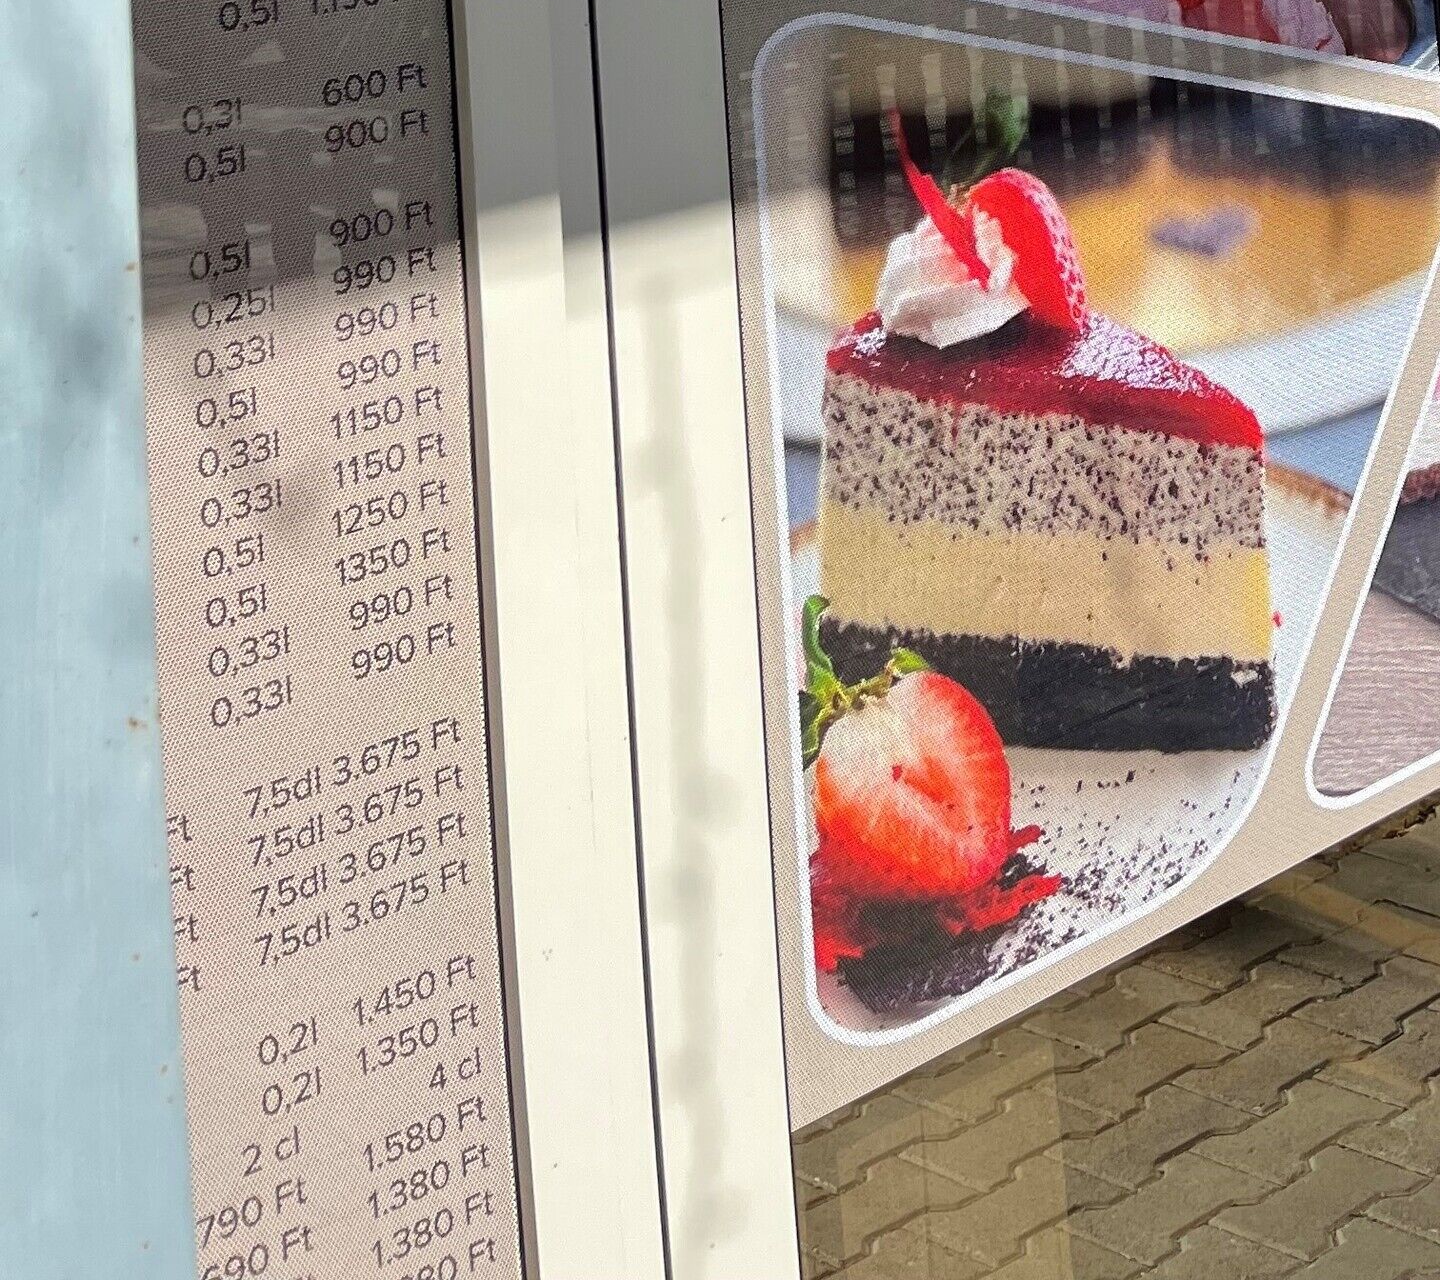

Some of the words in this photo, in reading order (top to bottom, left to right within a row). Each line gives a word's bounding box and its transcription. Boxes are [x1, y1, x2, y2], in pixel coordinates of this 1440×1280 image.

[183, 97, 241, 135] 0,3l
[322, 70, 386, 106] 600
[398, 63, 427, 92] Ft
[185, 145, 245, 183] 0,5l
[324, 116, 388, 152] 900
[401, 109, 429, 137] Ft
[190, 243, 250, 281] 0,5l
[329, 208, 393, 246] 900
[405, 201, 433, 231] Ft
[191, 285, 274, 330] 0,25l
[333, 257, 396, 294] 990
[408, 248, 436, 276] Ft
[194, 334, 274, 379] 0,33l
[336, 304, 398, 341] 990
[411, 294, 438, 323] Ft
[196, 387, 256, 428] 0,5l
[338, 349, 401, 390] 990
[412, 341, 441, 371] Ft
[199, 430, 280, 478] 0,33l
[330, 397, 403, 440] 1150
[415, 388, 443, 418] Ft
[201, 479, 282, 528] 0,33l
[332, 444, 405, 488] 1150
[417, 434, 445, 463] Ft
[204, 534, 264, 578] 0,5l
[331, 492, 407, 537] 1250
[419, 480, 448, 510] Ft
[205, 583, 267, 628] 0,5l
[336, 540, 411, 586] 1350
[421, 528, 450, 559] Ft
[208, 627, 290, 678] 0,33l
[350, 588, 412, 631] 990
[424, 575, 453, 606] Ft
[211, 676, 292, 728] 0,33l
[351, 635, 415, 678] 990
[426, 623, 455, 654] Ft
[332, 729, 421, 786] 3.675
[430, 719, 461, 751] Ft
[336, 778, 424, 834] 3.675
[433, 766, 464, 798] Ft
[339, 826, 427, 884] 3.675
[436, 813, 467, 845] Ft
[343, 873, 430, 932] 3.675
[439, 860, 470, 893] Ft
[259, 1017, 318, 1066] 0,2l
[352, 971, 435, 1027] 1.450
[446, 954, 476, 987] Ft
[262, 1067, 322, 1115] 0,2l
[357, 1018, 439, 1075] 1.350
[450, 1002, 480, 1036] Ft
[242, 1146, 262, 1177] 2
[276, 1127, 300, 1161] cl
[428, 1064, 446, 1090] 4
[458, 1048, 482, 1078] cl
[274, 1178, 308, 1214] Ft
[363, 1112, 446, 1172] 1.580
[456, 1097, 487, 1131] Ft
[280, 1226, 314, 1261] Ft
[367, 1159, 451, 1219] 1.380
[461, 1143, 491, 1178] Ft
[372, 1207, 454, 1268] 1.380
[464, 1191, 494, 1225] Ft
[468, 1238, 496, 1272] Ft
